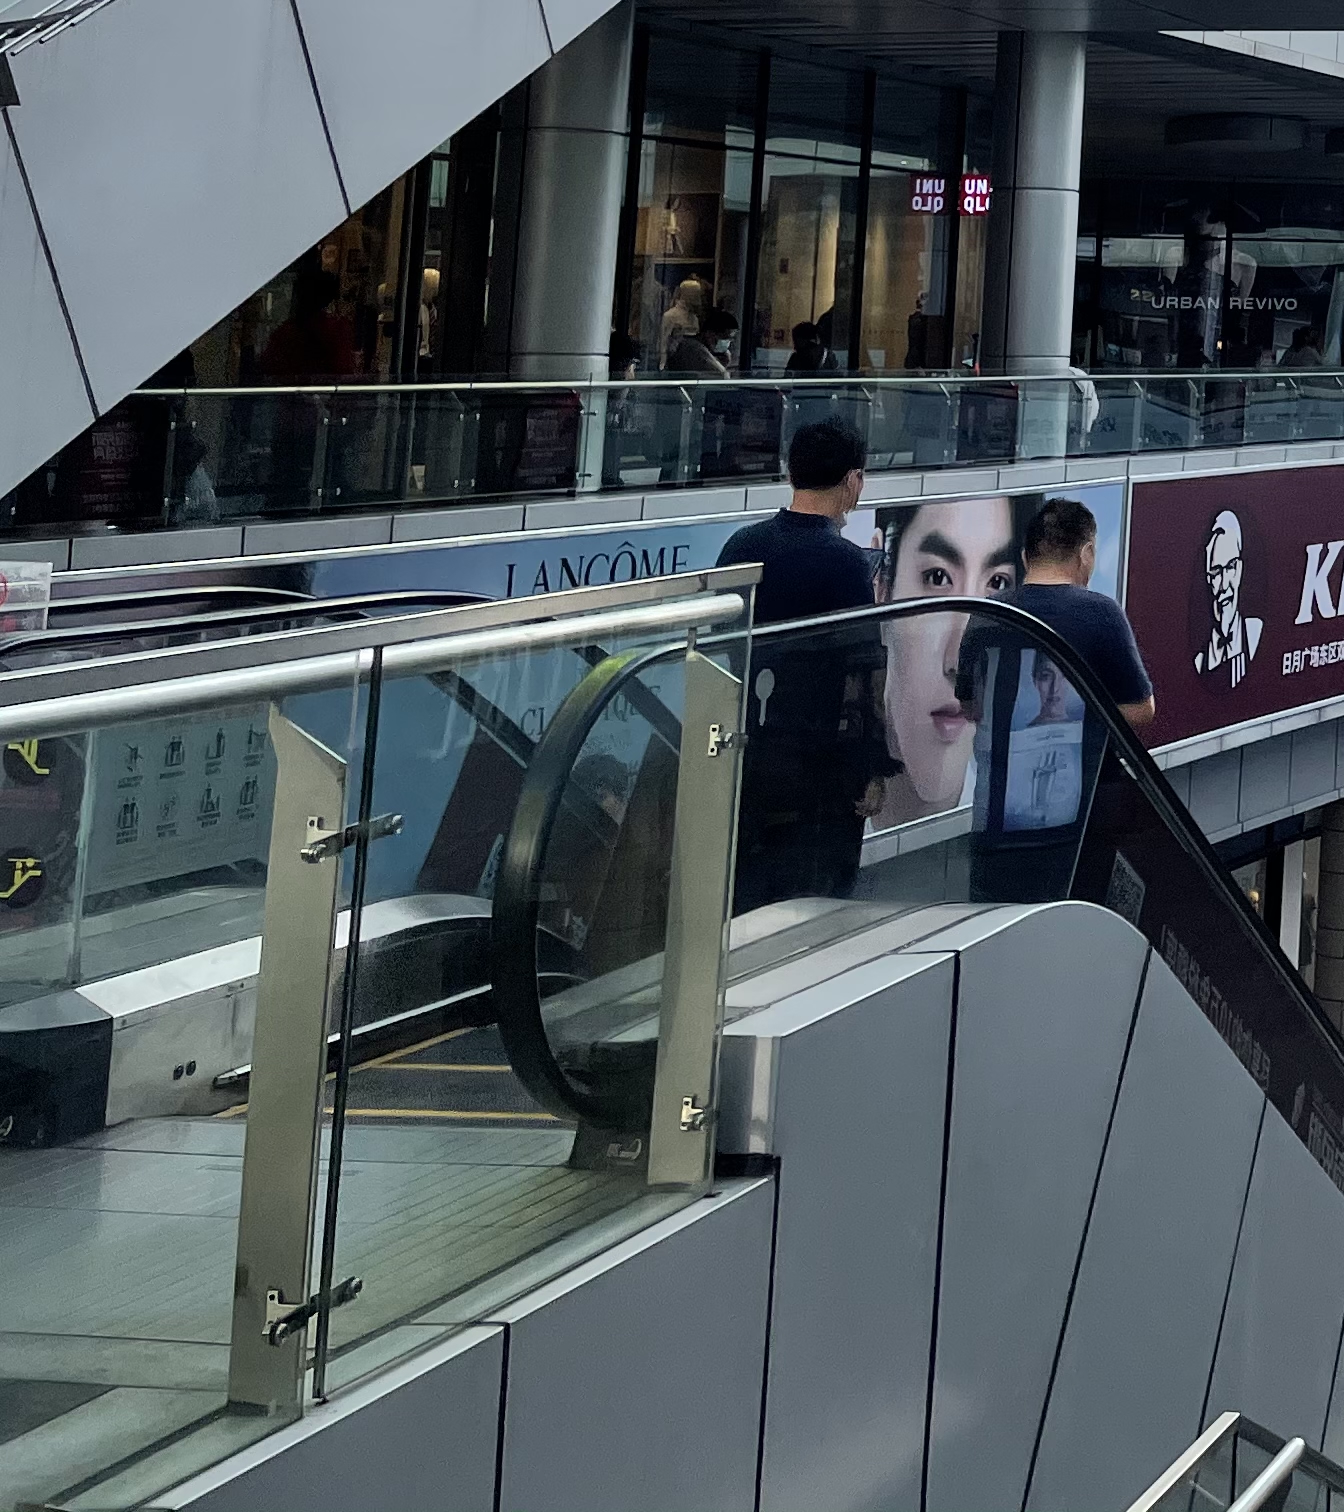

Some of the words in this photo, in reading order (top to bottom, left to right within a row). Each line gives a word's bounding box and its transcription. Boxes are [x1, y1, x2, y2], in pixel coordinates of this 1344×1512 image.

[964, 178, 988, 194] UN
[1151, 296, 1220, 310] URBAN
[1229, 296, 1298, 311] REVIVO
